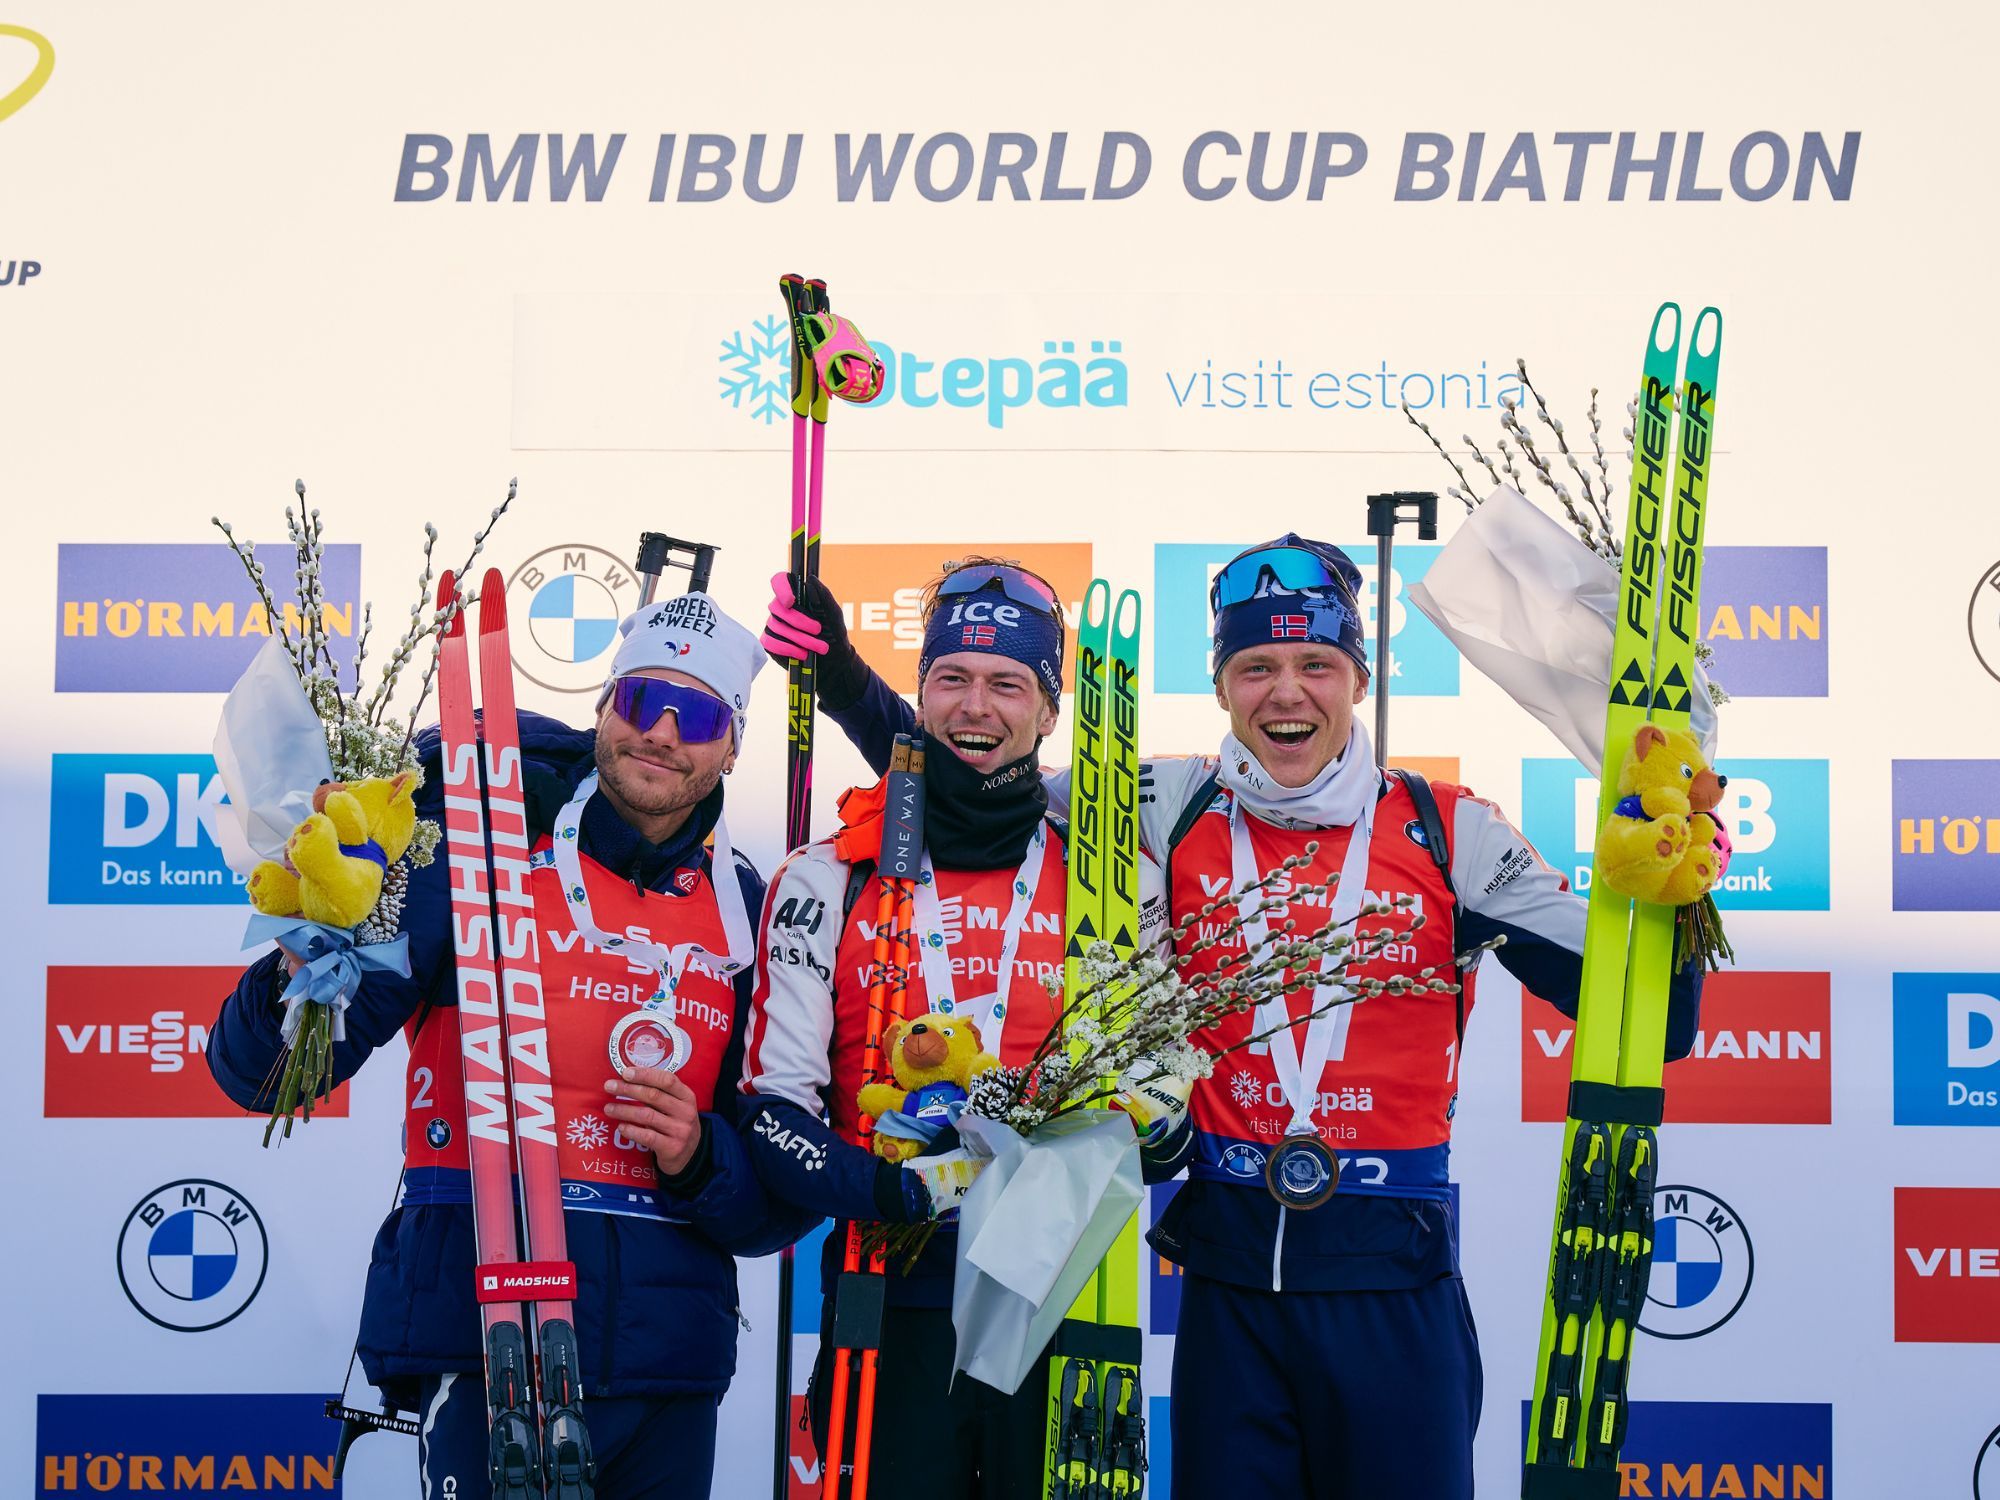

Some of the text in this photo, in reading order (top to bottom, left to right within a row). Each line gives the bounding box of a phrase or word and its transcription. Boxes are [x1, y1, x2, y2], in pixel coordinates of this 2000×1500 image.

[394, 131, 1862, 204] BMW IBU WORLD CUP BIATHLON
[1166, 361, 1303, 409] visit
[1308, 361, 1526, 410] estonia
[1627, 376, 1670, 640] FISCHER
[1669, 380, 1712, 645] FISCHER
[520, 552, 630, 592] BMW
[64, 598, 353, 637] HÖRMANN
[666, 614, 716, 639] WEEZ
[947, 601, 1022, 628] ice
[1040, 660, 1061, 696] CRAFT
[912, 761, 924, 769] MV
[1077, 646, 1102, 896] FISCHER
[1113, 658, 1135, 907] FISCHER
[102, 861, 151, 886] Das
[161, 861, 222, 886] kann
[441, 740, 509, 1144] MADSHUS
[484, 742, 558, 1147] MADSHUS
[569, 976, 730, 1033] Heat umps
[412, 1066, 433, 1110] 2
[1947, 1082, 1998, 1106] Das
[753, 1109, 818, 1160] CRAFT
[582, 1157, 628, 1177] visit
[1225, 1147, 1264, 1166] BMW
[139, 1187, 250, 1230] BMW
[1664, 1193, 1734, 1234] MW
[504, 1276, 570, 1287] MADSHUS
[44, 1452, 334, 1491] HÖRMANN
